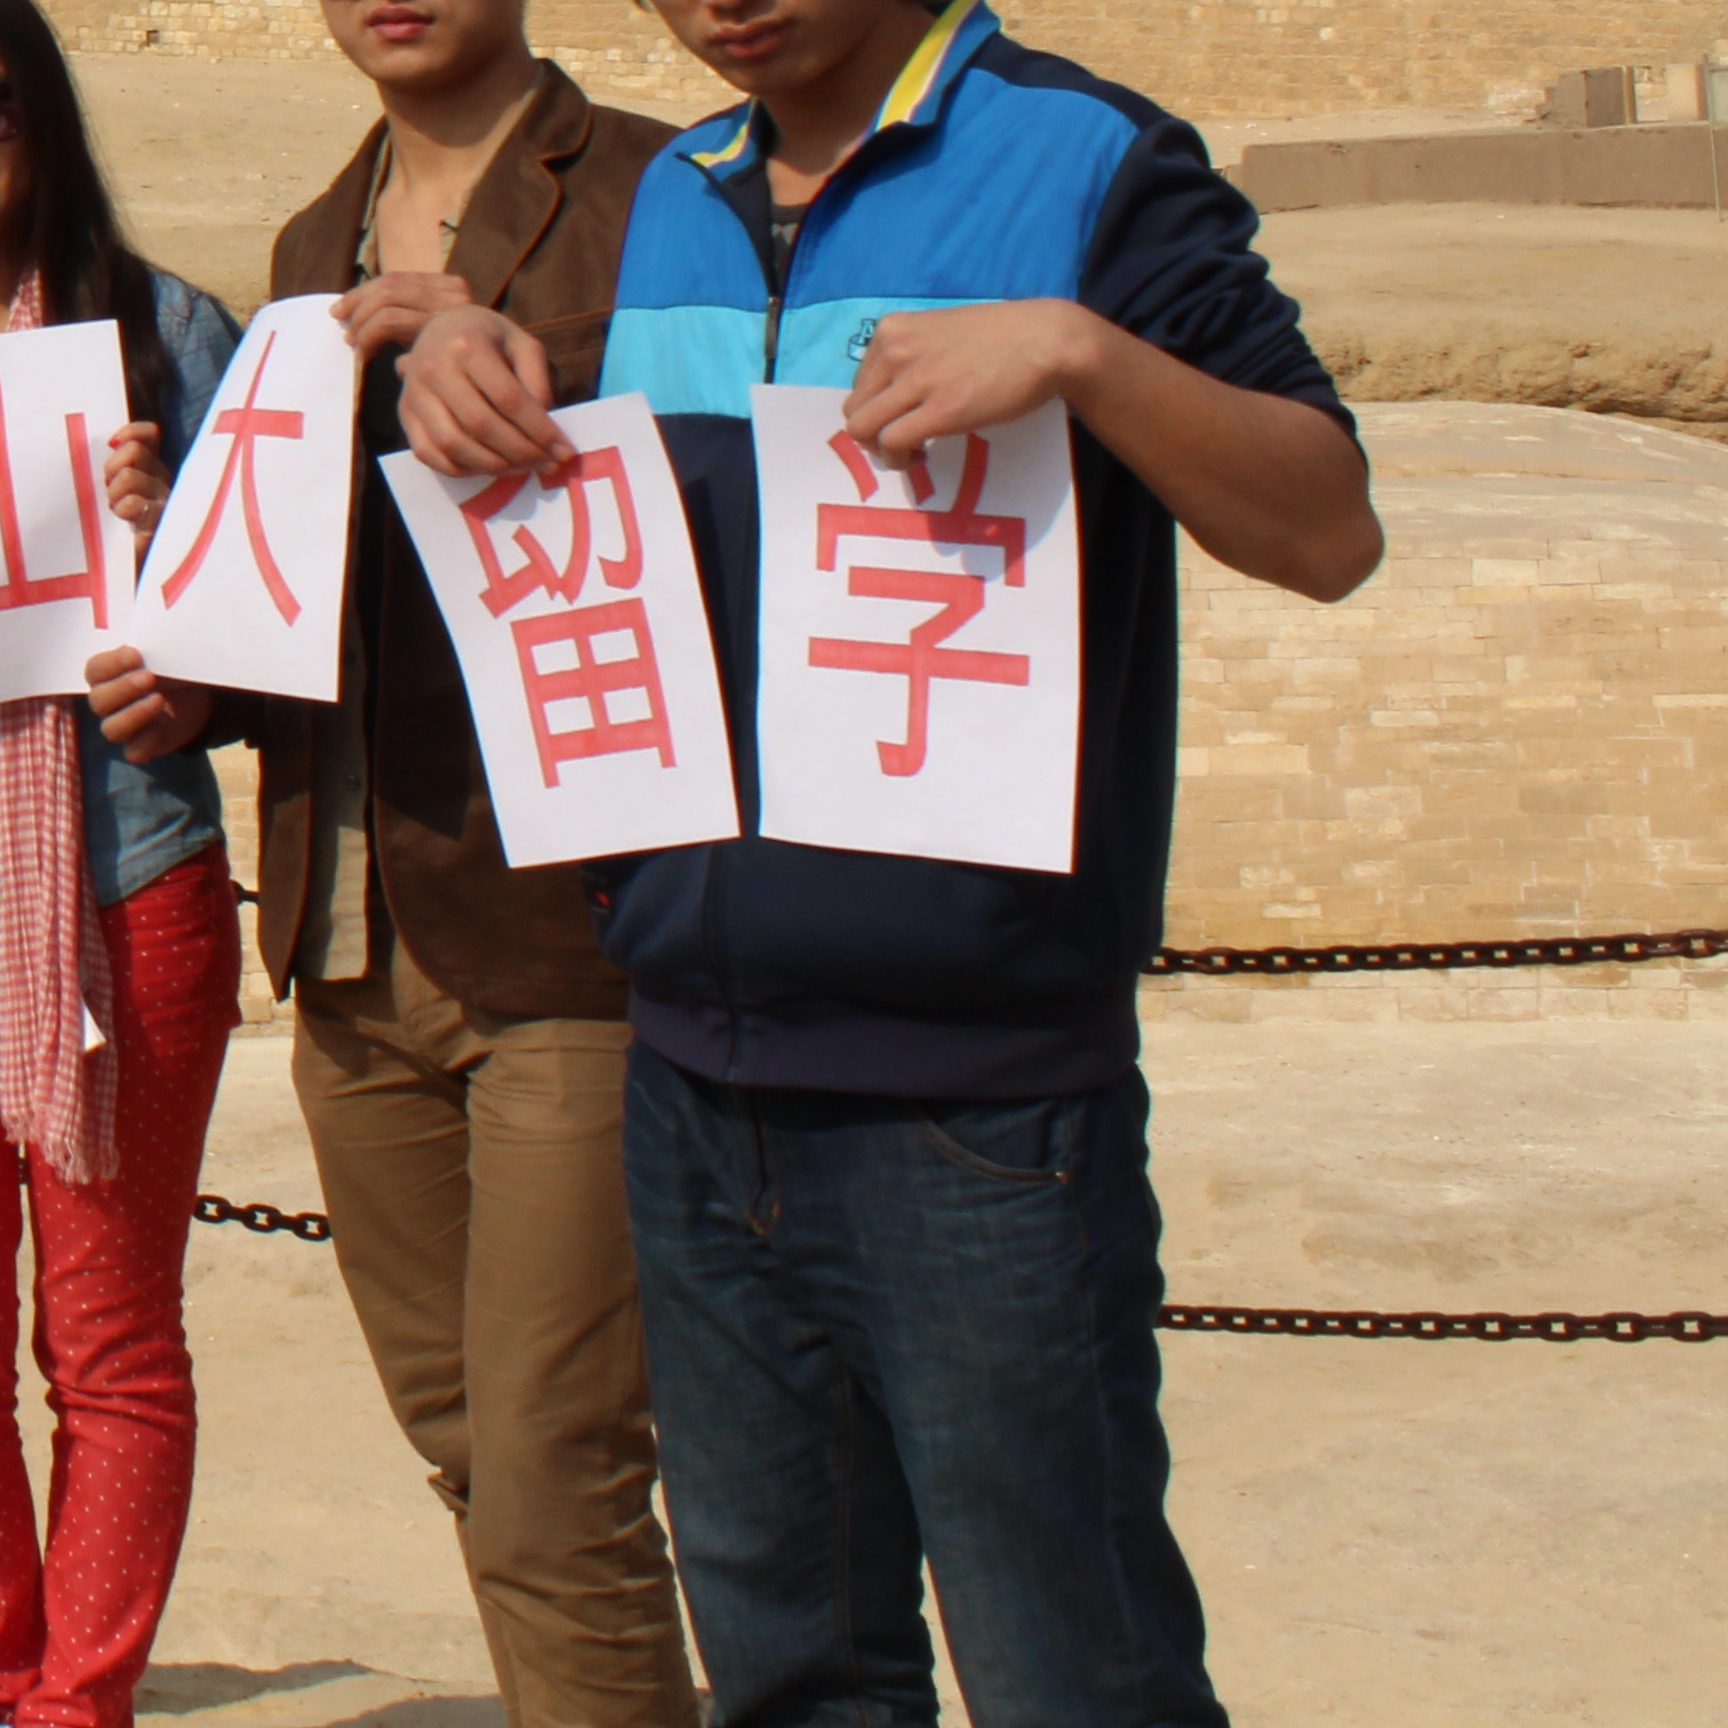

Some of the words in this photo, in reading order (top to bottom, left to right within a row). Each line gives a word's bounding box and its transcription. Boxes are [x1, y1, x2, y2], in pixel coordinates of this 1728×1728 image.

[161, 331, 305, 627] 大
[458, 444, 677, 789] 留
[807, 429, 1031, 777] 学
